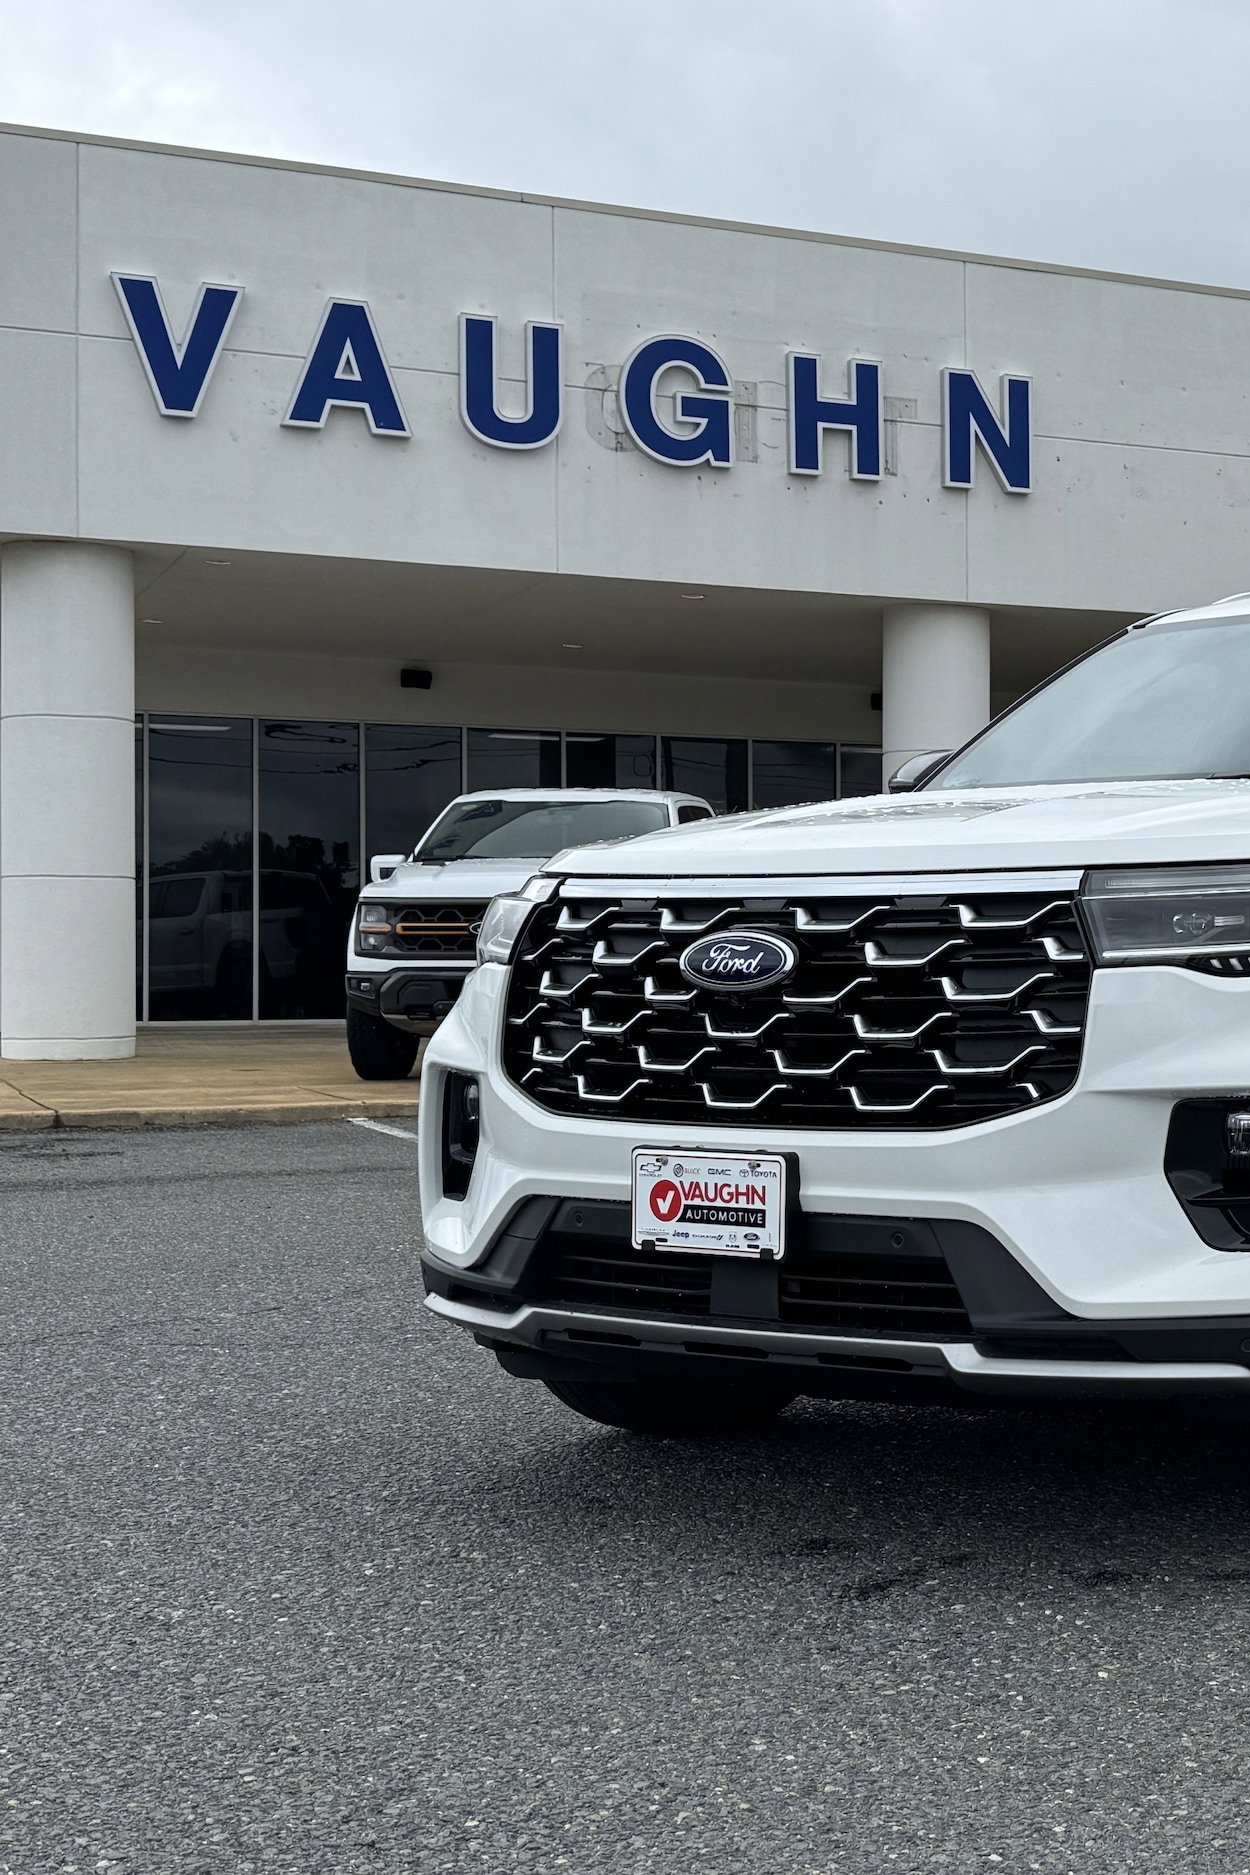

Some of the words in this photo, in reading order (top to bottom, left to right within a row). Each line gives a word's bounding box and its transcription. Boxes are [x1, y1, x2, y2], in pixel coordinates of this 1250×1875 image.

[110, 271, 1032, 494] VAUGHN
[702, 943, 764, 974] Ford
[708, 1168, 731, 1176] GMC
[751, 1170, 777, 1178] TOYOTA
[679, 1180, 766, 1206] VAUGHN
[685, 1209, 763, 1224] AUTOMOTIVE
[672, 1230, 690, 1239] Jeep
